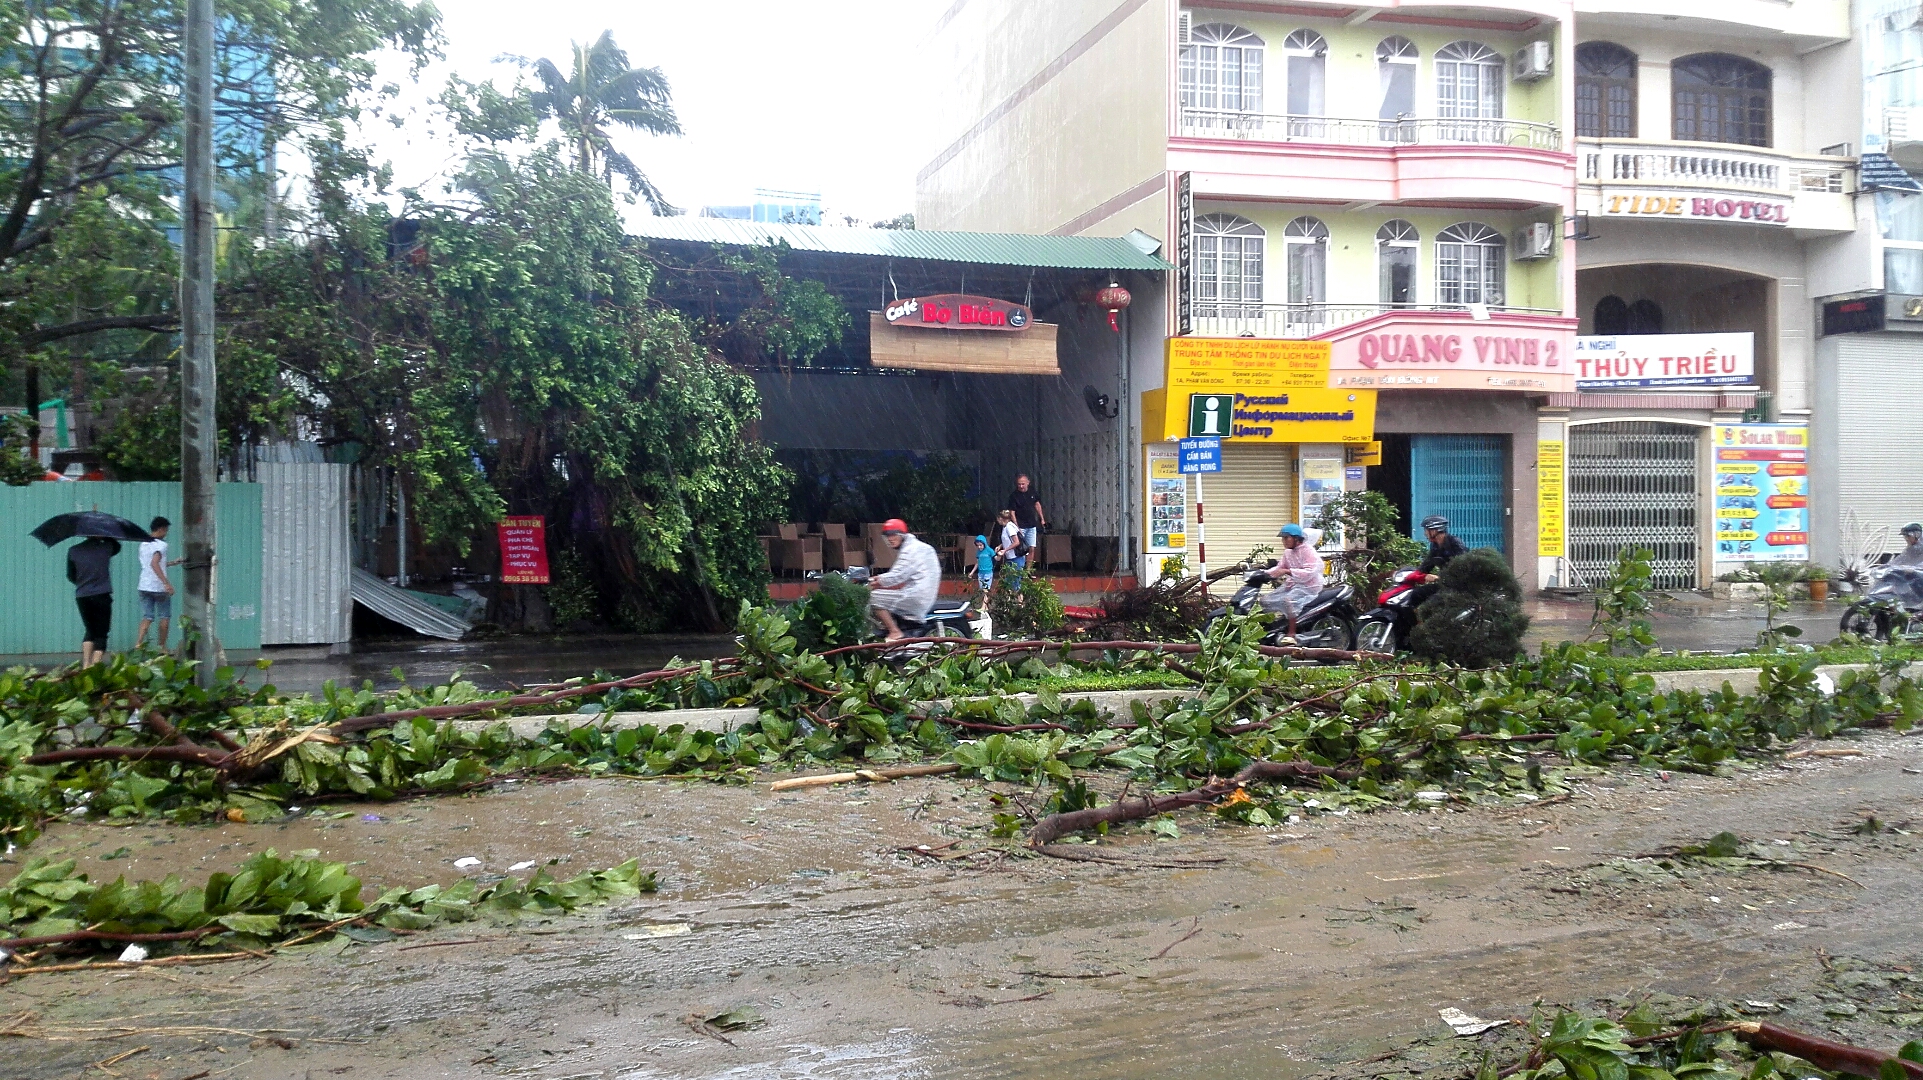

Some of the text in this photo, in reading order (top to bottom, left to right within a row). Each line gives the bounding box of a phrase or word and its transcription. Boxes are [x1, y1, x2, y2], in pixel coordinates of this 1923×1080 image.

[1608, 195, 1790, 223] TIDE HOTEL
[1181, 194, 1189, 260] QUANG
[1181, 265, 1189, 316] VINH
[885, 298, 918, 321] Café
[959, 301, 1005, 326] Biển
[1181, 319, 1189, 330] 2
[1174, 340, 1194, 348] CÔNG
[1235, 342, 1250, 350] LỊCH
[1358, 333, 1559, 369] QUANG VINH 2
[1174, 349, 1203, 358] TRUNG
[1205, 349, 1222, 358] TÂM
[1225, 349, 1253, 359] THÔNG
[1255, 351, 1267, 359] TIN
[1283, 352, 1301, 361] LỊCH
[1576, 347, 1736, 378] THỦY TRIỀU
[1235, 393, 1288, 407] Русский
[1234, 409, 1354, 422] Информационный
[1233, 424, 1273, 438] Центр
[1181, 439, 1219, 450] TUYẾN ĐƯỜNG
[1186, 450, 1199, 461] CẤM
[1200, 450, 1212, 460] BÁN
[1183, 462, 1217, 472] HÀNG RONG
